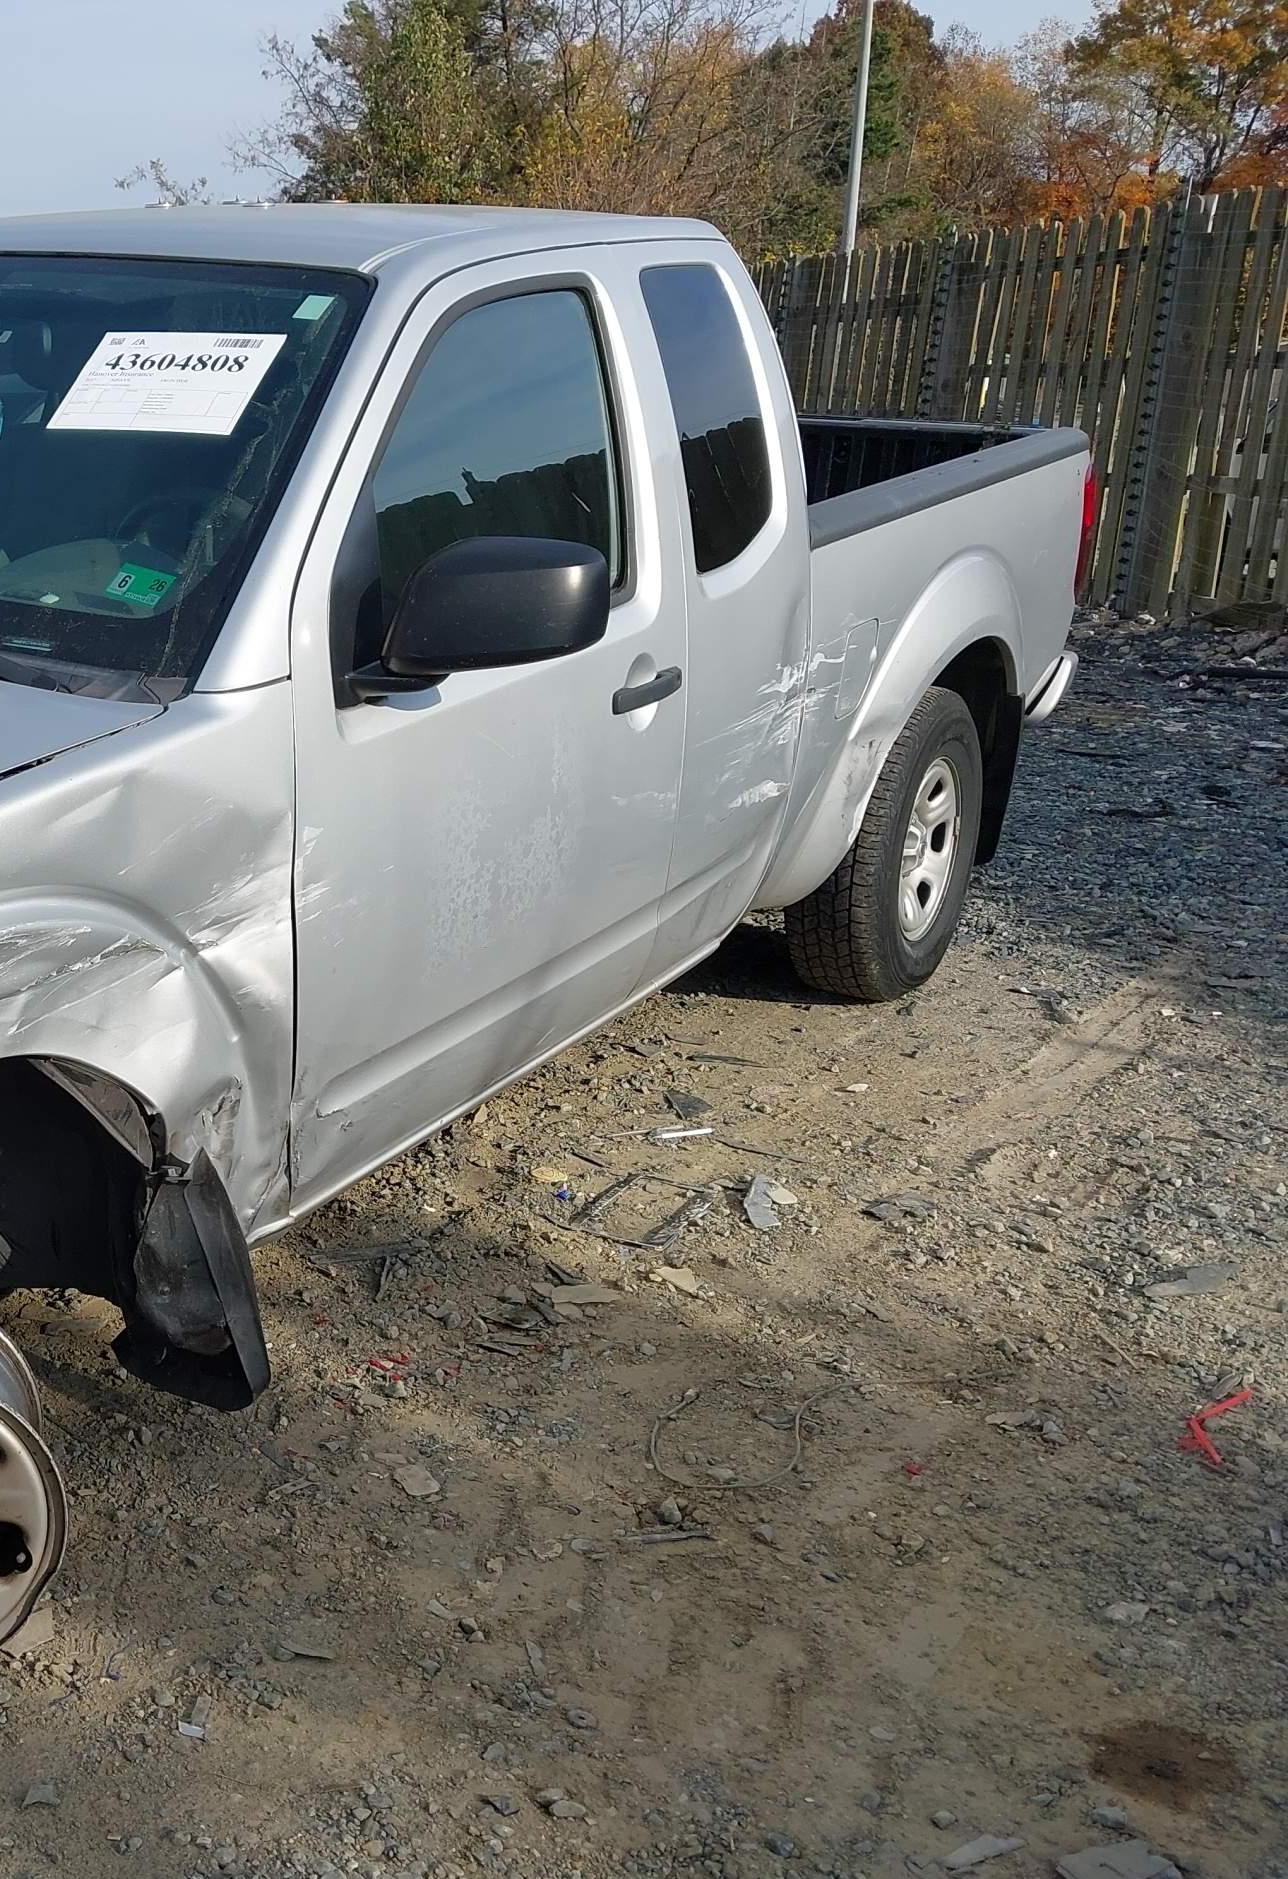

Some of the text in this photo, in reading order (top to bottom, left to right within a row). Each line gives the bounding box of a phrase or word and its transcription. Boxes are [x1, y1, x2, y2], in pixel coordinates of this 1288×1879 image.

[105, 353, 249, 373] 43604808
[117, 574, 132, 589] 6
[148, 578, 168, 592] 26
